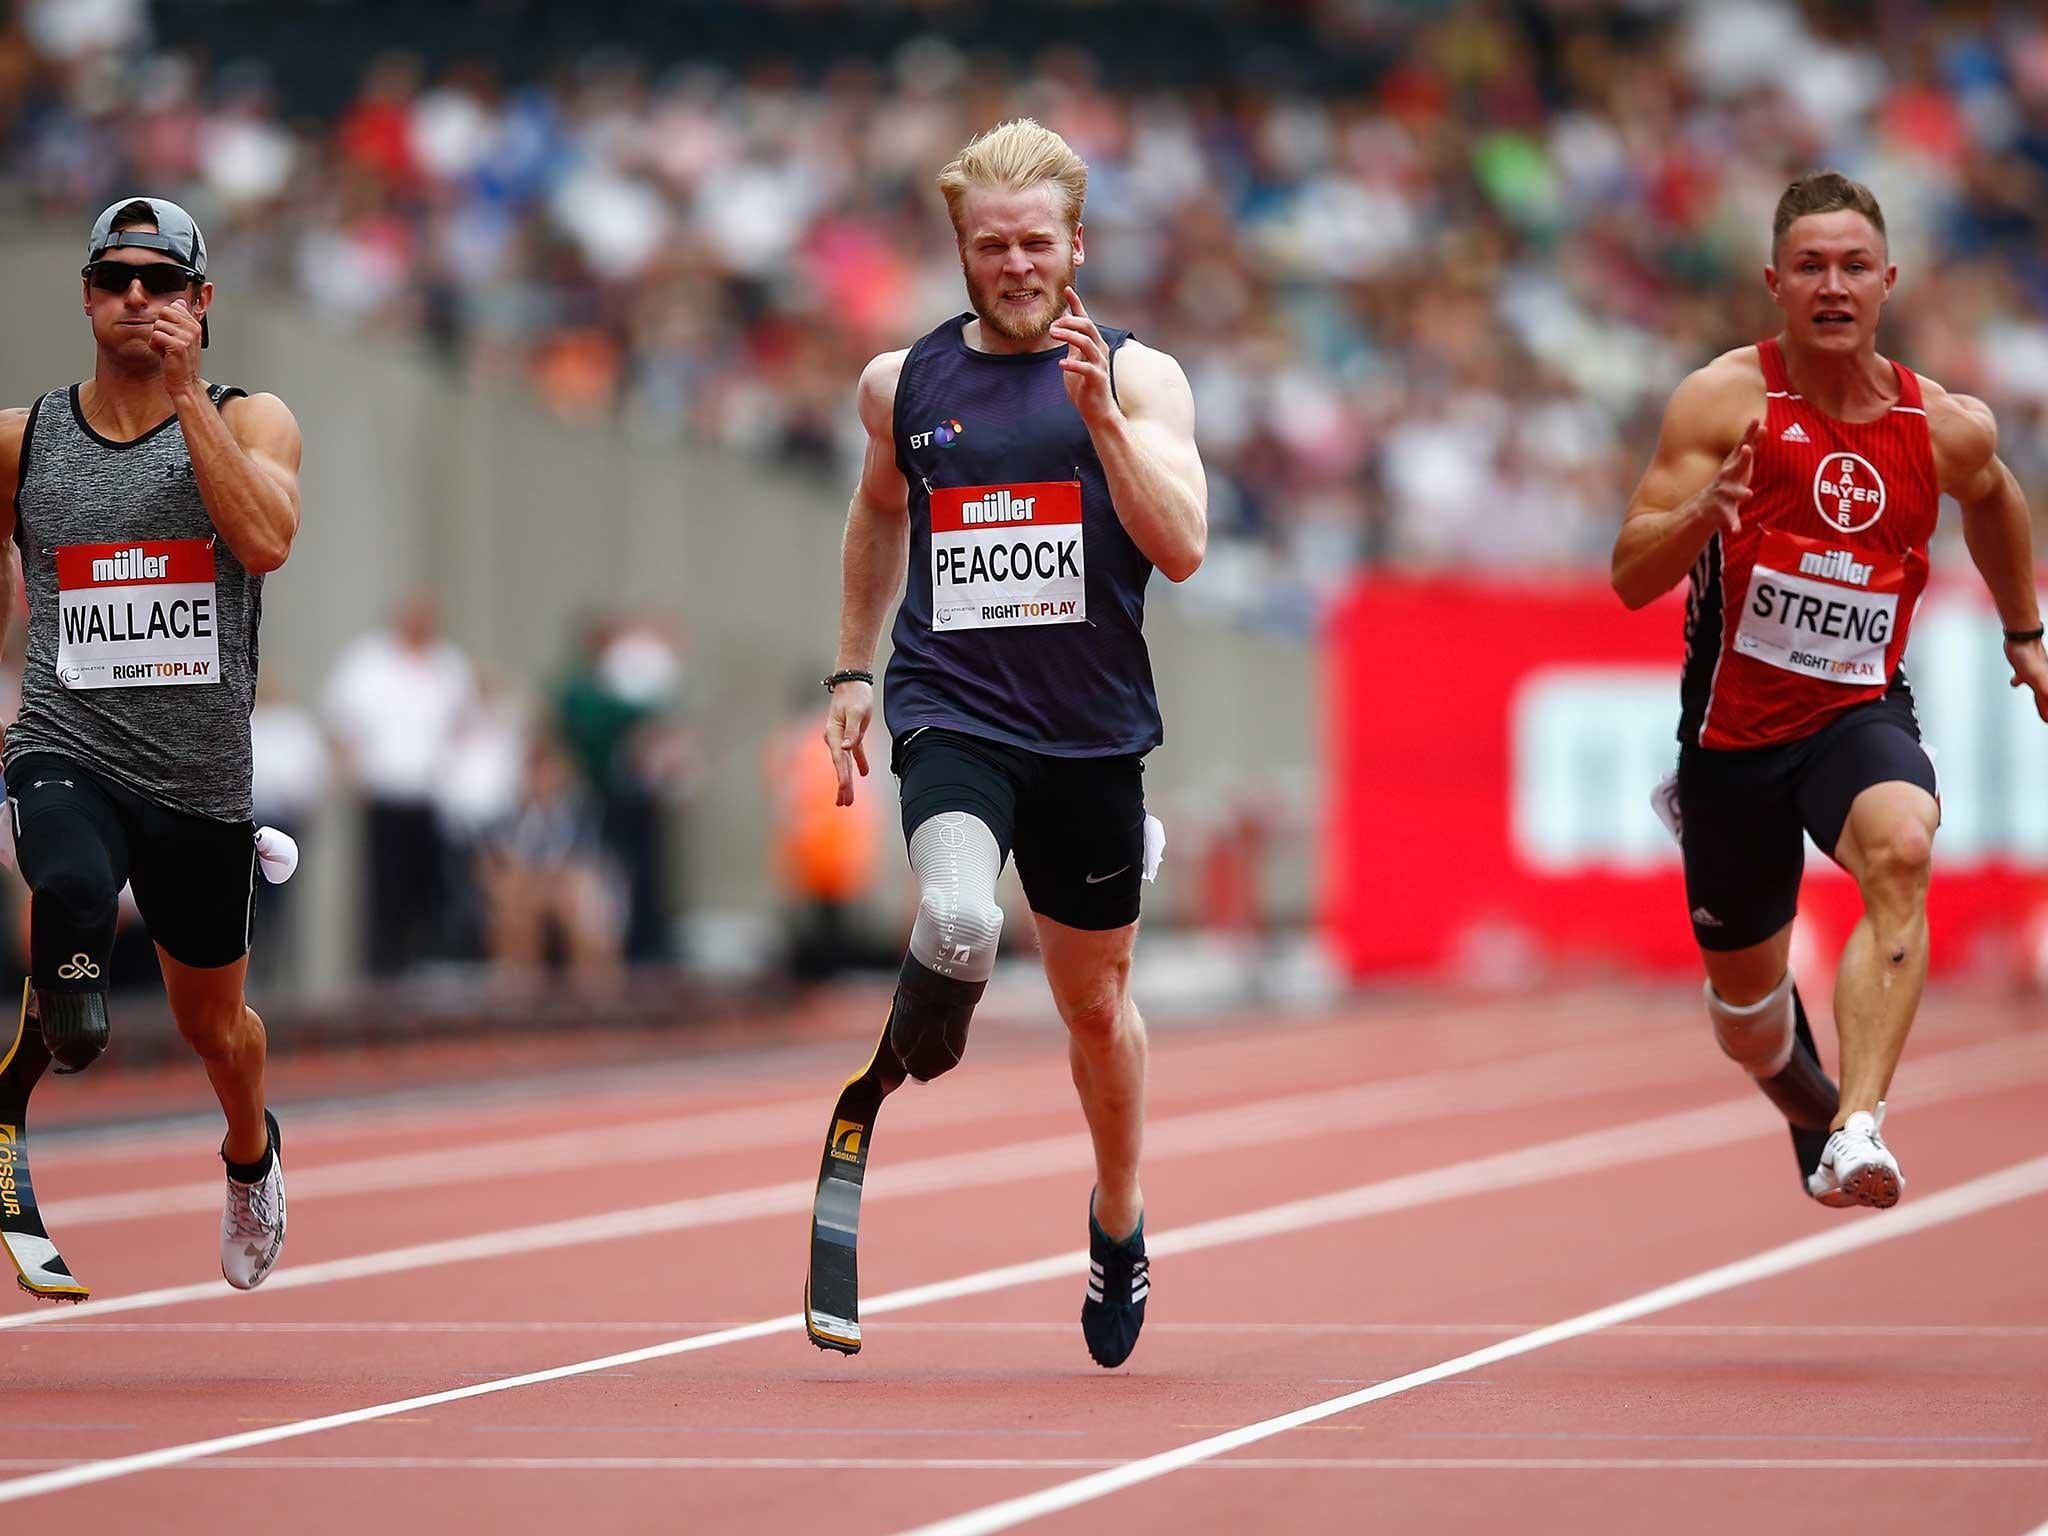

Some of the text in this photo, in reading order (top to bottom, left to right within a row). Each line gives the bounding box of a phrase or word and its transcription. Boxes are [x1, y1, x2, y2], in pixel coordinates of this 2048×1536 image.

[910, 431, 933, 449] BT
[962, 490, 1036, 524] müller
[1820, 480, 1880, 504] BAYER
[1838, 459, 1855, 526] BAYER
[92, 548, 170, 582] müller
[936, 540, 1079, 586] PEACOCK
[1799, 550, 1875, 587] müller
[64, 599, 213, 645] WALLACE
[1752, 583, 1889, 643] STRENG
